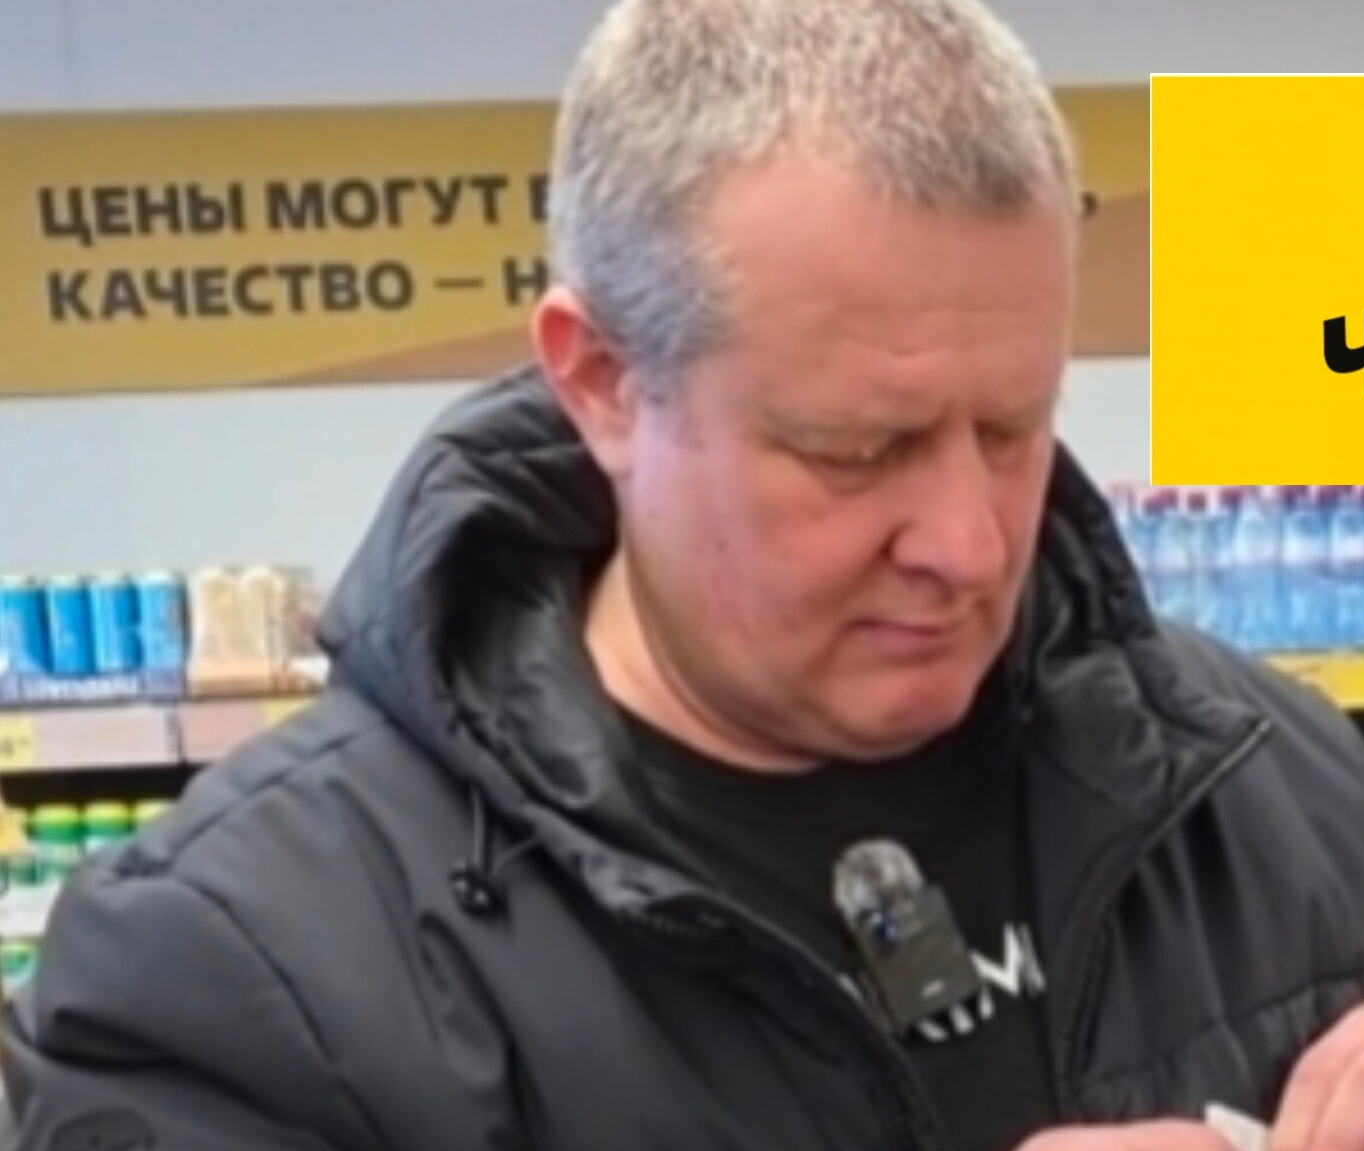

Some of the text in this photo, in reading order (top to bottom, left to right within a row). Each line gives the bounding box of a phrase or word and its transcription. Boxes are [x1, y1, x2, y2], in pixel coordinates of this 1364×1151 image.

[38, 182, 247, 247] ЦЕНЫ
[265, 174, 508, 231] МОГУТ
[48, 259, 415, 322] КАЧЕСТВО
